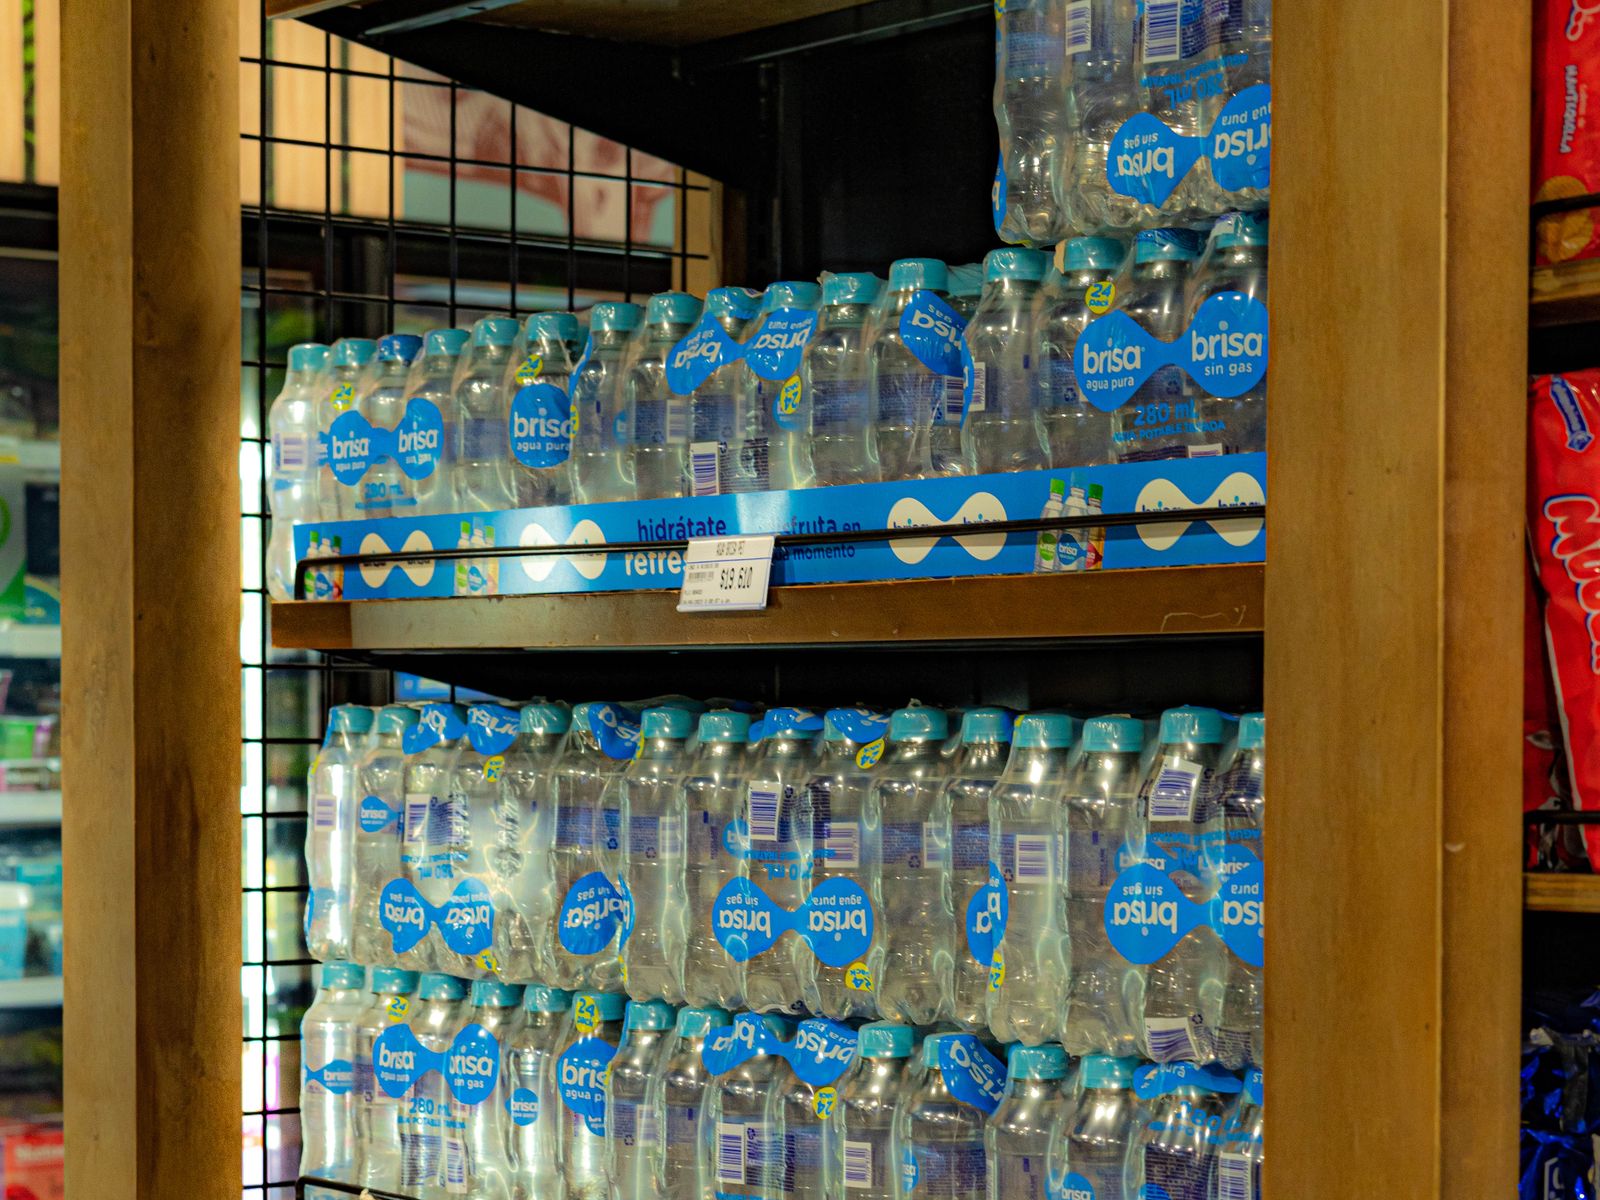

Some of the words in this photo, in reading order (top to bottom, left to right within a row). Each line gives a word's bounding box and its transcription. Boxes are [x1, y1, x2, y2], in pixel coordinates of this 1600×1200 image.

[1222, 110, 1248, 126] pura
[1124, 136, 1141, 148] gas
[1142, 132, 1158, 144] sin
[1214, 121, 1271, 165] risa
[1115, 146, 1174, 188] brisa
[1091, 283, 1112, 298] 24
[753, 326, 811, 357] brisa
[1191, 319, 1264, 362] brisa
[674, 341, 721, 369] brisa
[1082, 337, 1143, 374] brisa
[1204, 363, 1225, 376] sin
[1229, 361, 1253, 375] gas
[1086, 379, 1108, 391] agua
[1110, 376, 1135, 390] pura
[332, 432, 370, 458] brisa
[398, 422, 439, 453] brisa
[517, 441, 542, 452] agua
[638, 516, 727, 542] hidrátate
[793, 544, 856, 560] momento
[577, 886, 594, 901] gas
[1122, 886, 1143, 897] gas
[1146, 885, 1163, 897] sin
[1230, 883, 1259, 896] pura
[726, 895, 741, 906] gas
[836, 895, 862, 906] agua
[384, 901, 425, 932] brisa
[719, 908, 772, 940] brisa
[1113, 901, 1178, 936] brisa
[809, 909, 867, 942] brisa
[391, 998, 407, 1012] 24
[577, 997, 595, 1015] 24
[378, 1045, 416, 1070] brisa
[950, 1040, 1007, 1104] risa
[467, 1078, 485, 1089] gas
[566, 1089, 591, 1099] agua
[409, 1099, 436, 1114] 280
